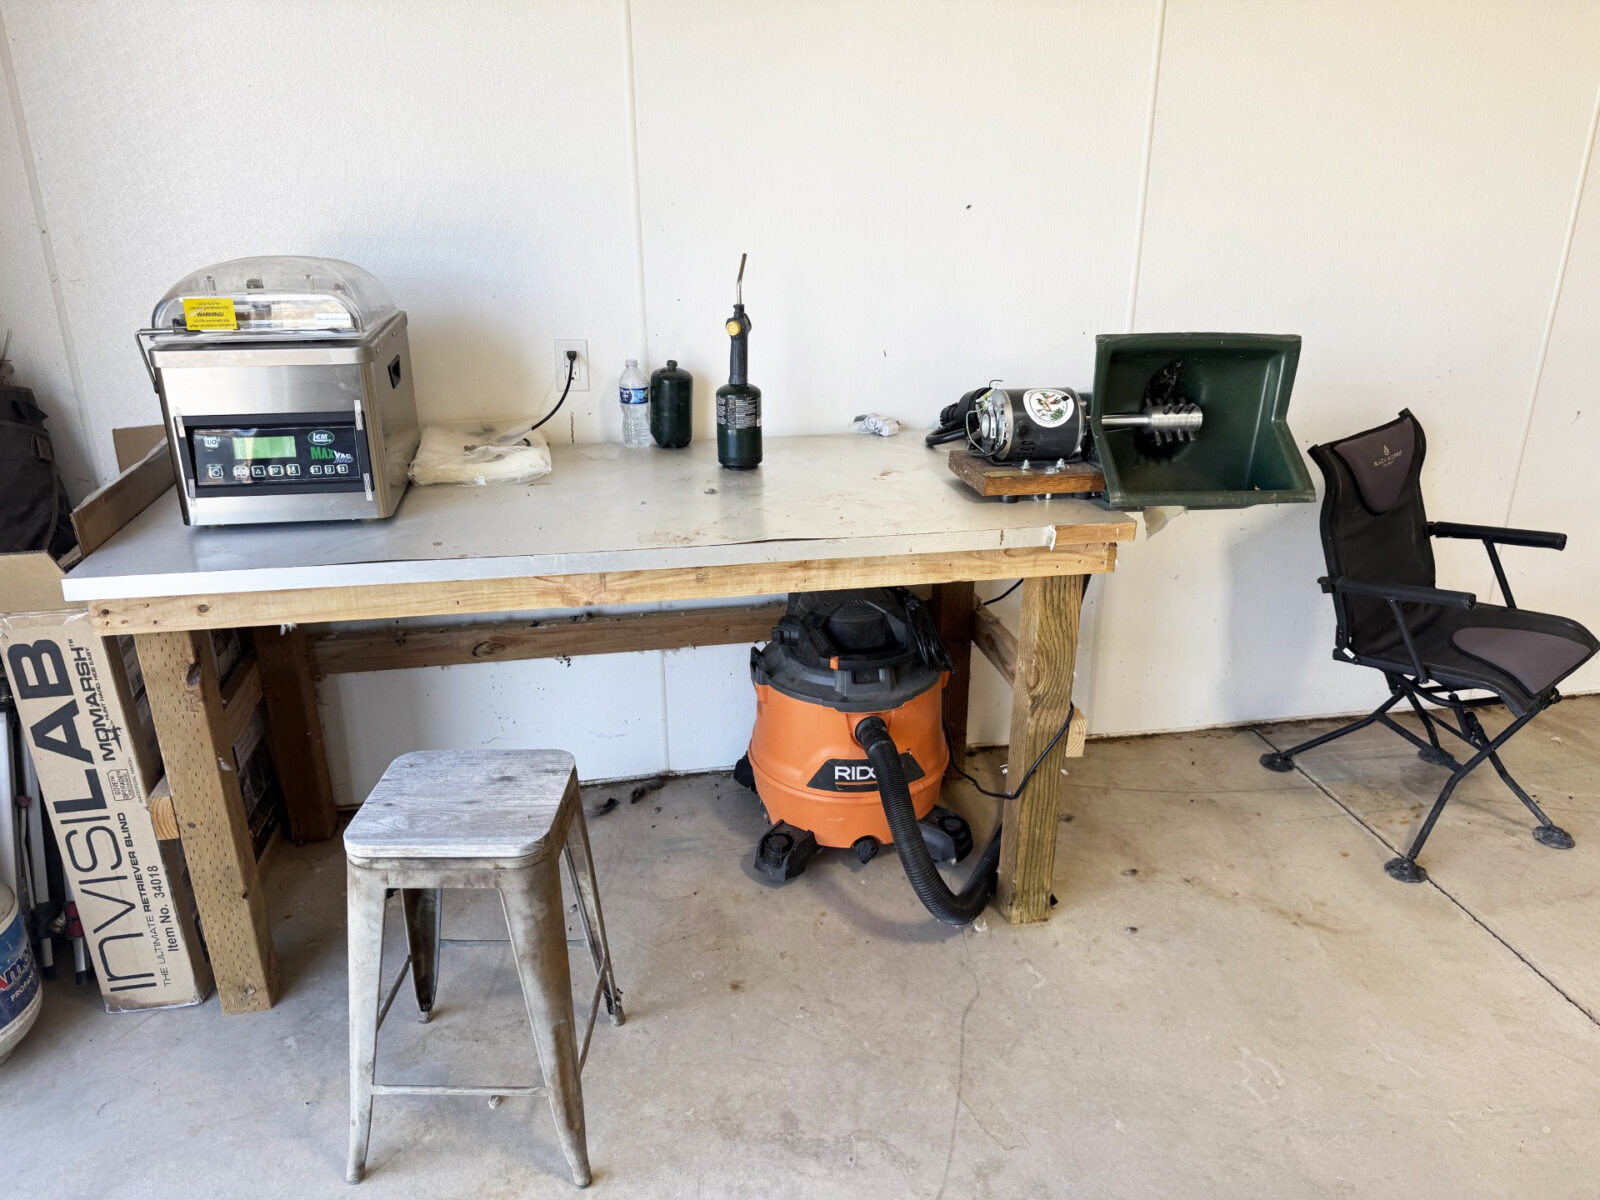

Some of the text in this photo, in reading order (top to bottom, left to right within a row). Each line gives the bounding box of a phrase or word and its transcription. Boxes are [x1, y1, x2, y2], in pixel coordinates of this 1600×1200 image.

[834, 766, 876, 780] RID
[117, 813, 133, 847] BLIND
[128, 851, 151, 912] RETRIEVER
[147, 865, 179, 952] Item No. 34018
[146, 916, 165, 965] ULTIMATE
[160, 967, 170, 988] THE
